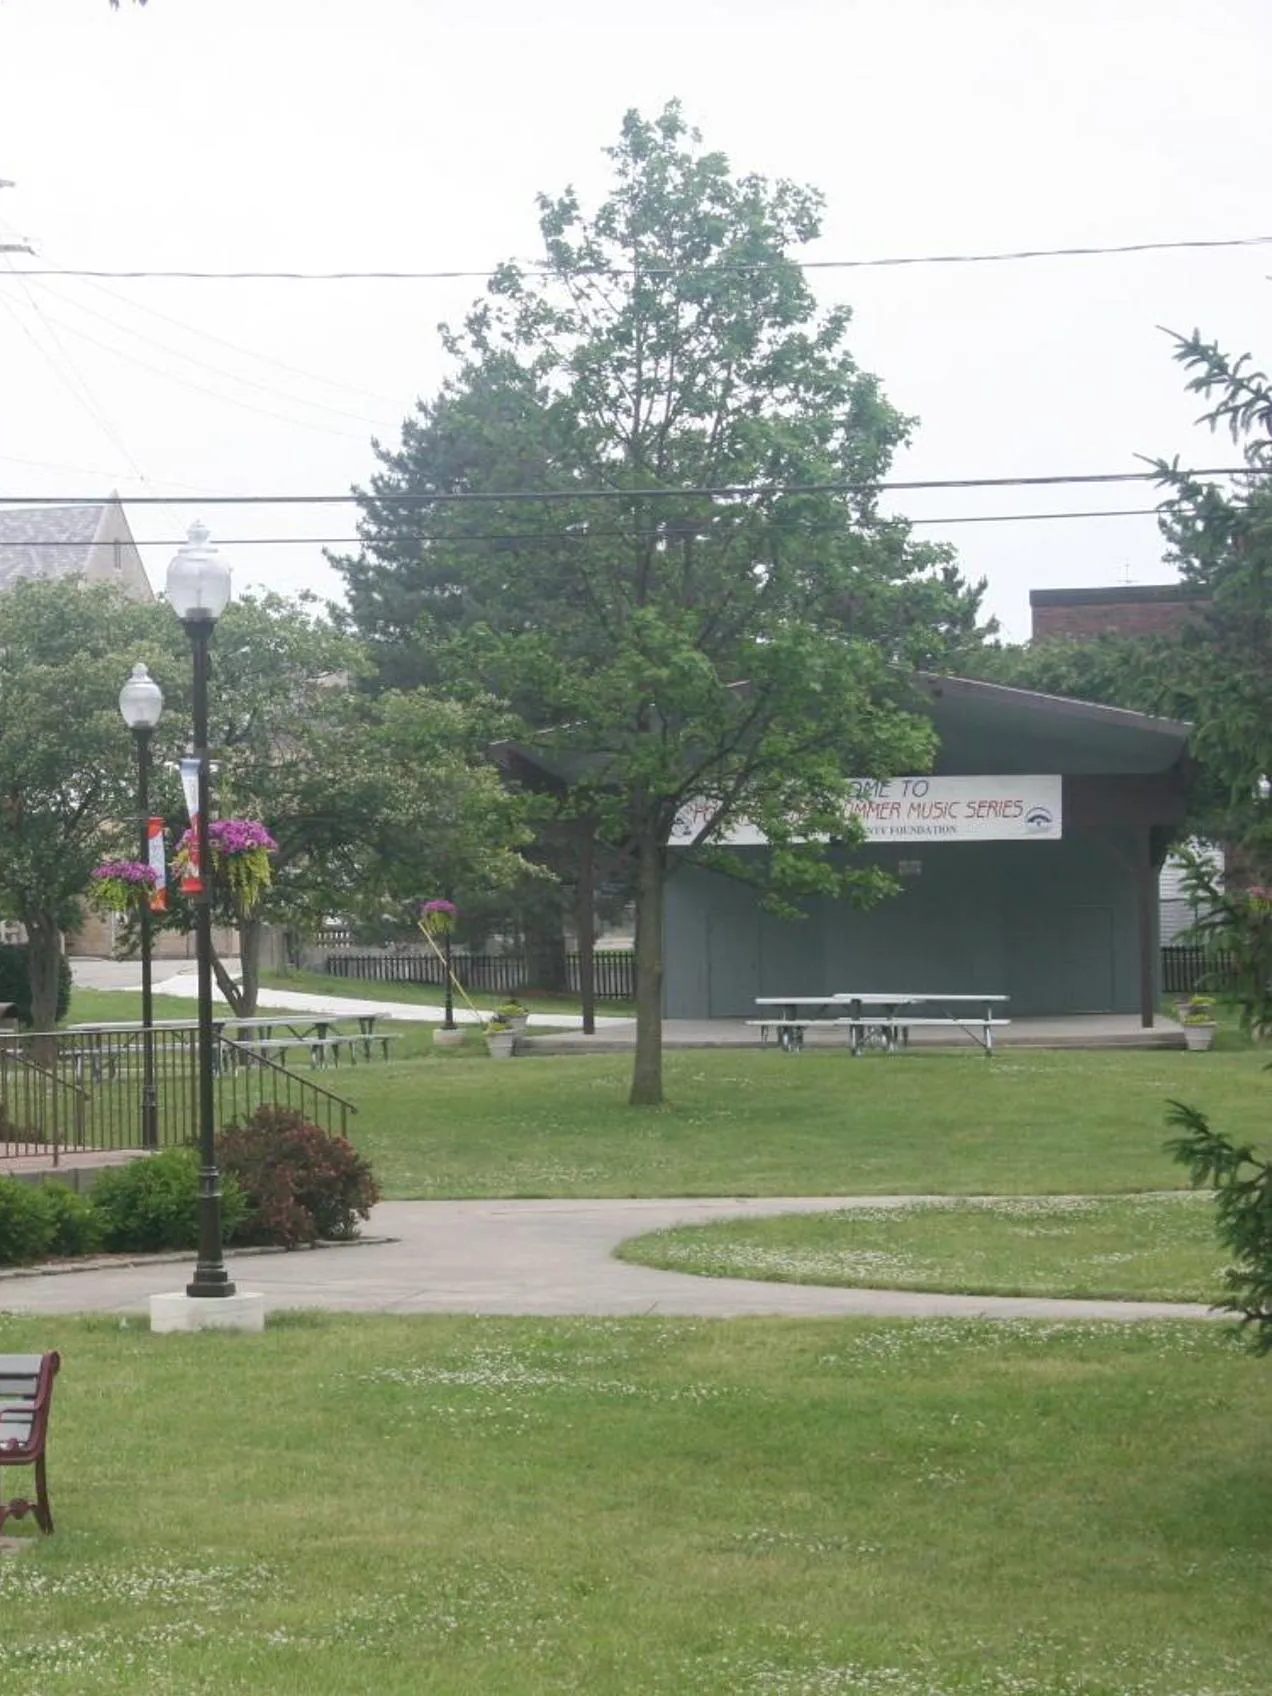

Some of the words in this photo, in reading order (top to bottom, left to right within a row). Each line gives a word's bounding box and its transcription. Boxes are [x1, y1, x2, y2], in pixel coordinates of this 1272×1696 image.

[903, 780, 929, 797] TO
[907, 801, 961, 819] MUSIC
[965, 799, 1024, 818] SERIES
[890, 825, 957, 837] FOUNDATION
